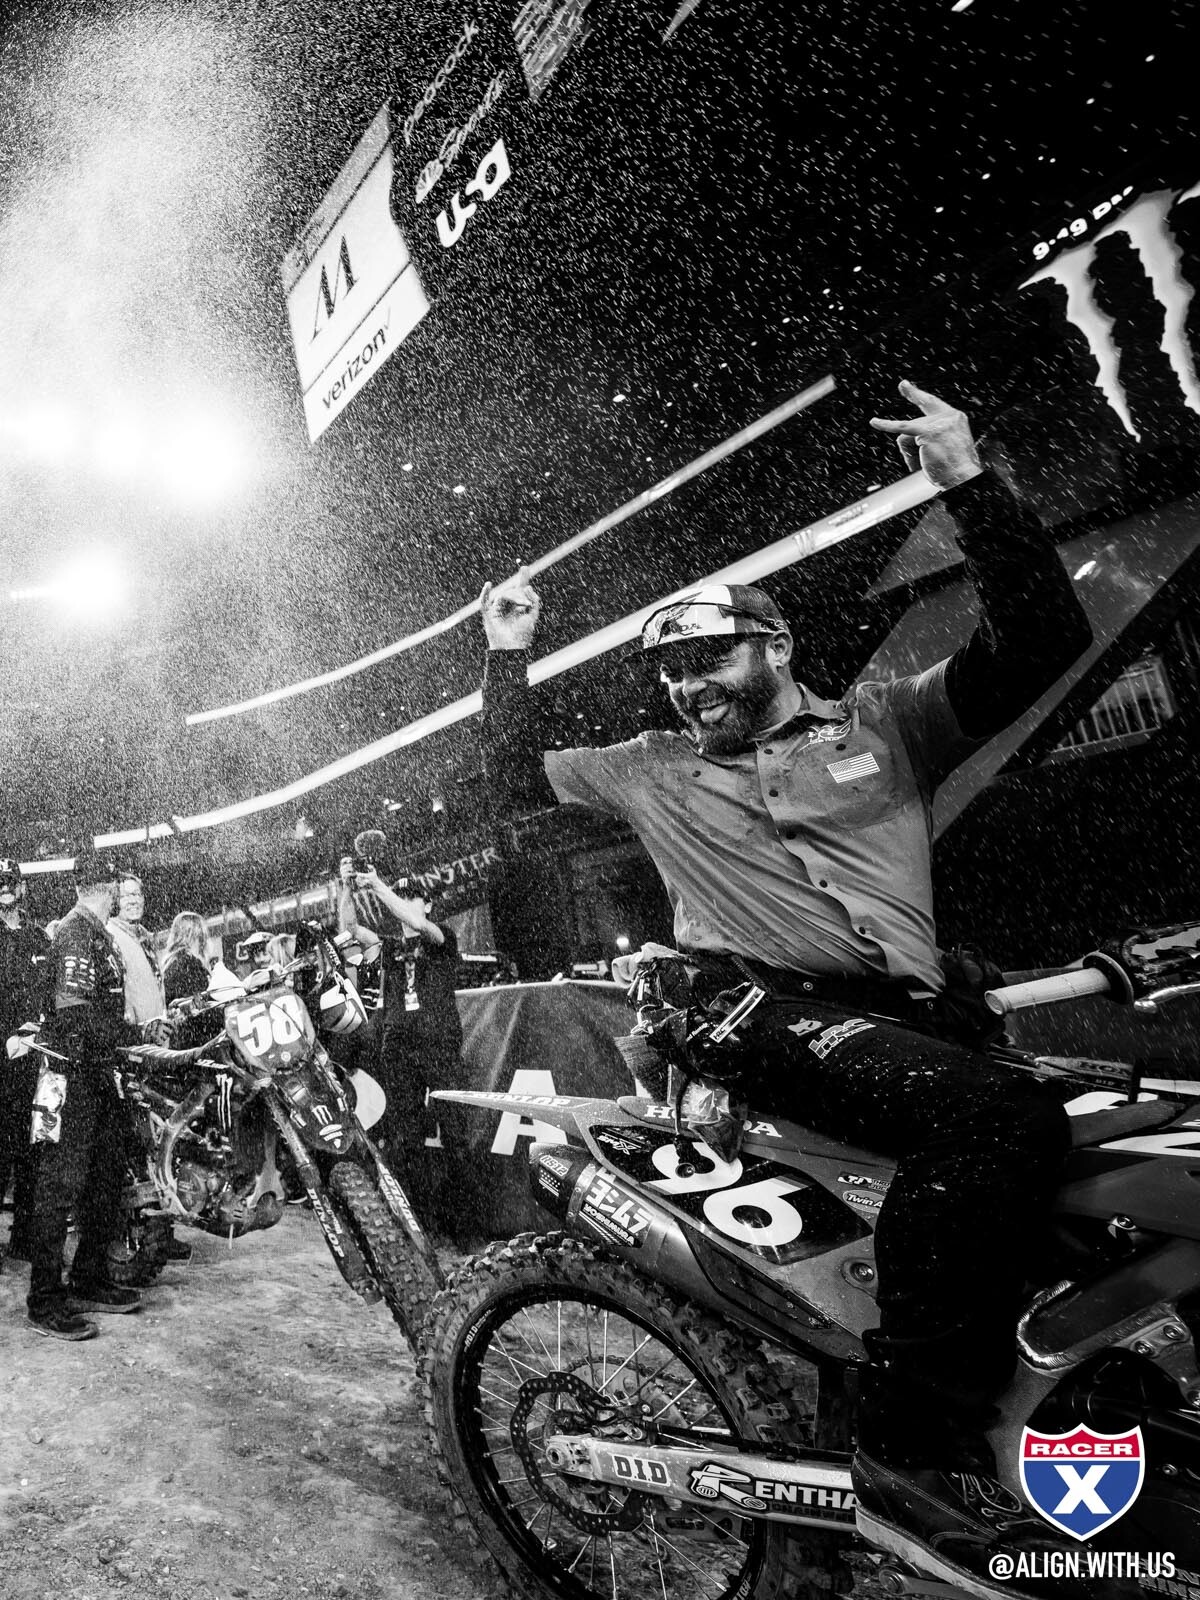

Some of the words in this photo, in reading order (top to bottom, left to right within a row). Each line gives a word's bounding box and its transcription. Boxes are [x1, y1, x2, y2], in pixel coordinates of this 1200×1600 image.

[322, 326, 388, 410] verizon
[236, 994, 305, 1057] 58
[306, 1187, 346, 1259] DUNLOP
[641, 1142, 810, 1247] 96
[847, 1193, 875, 1207] Twin
[689, 1464, 861, 1513] RENTHA
